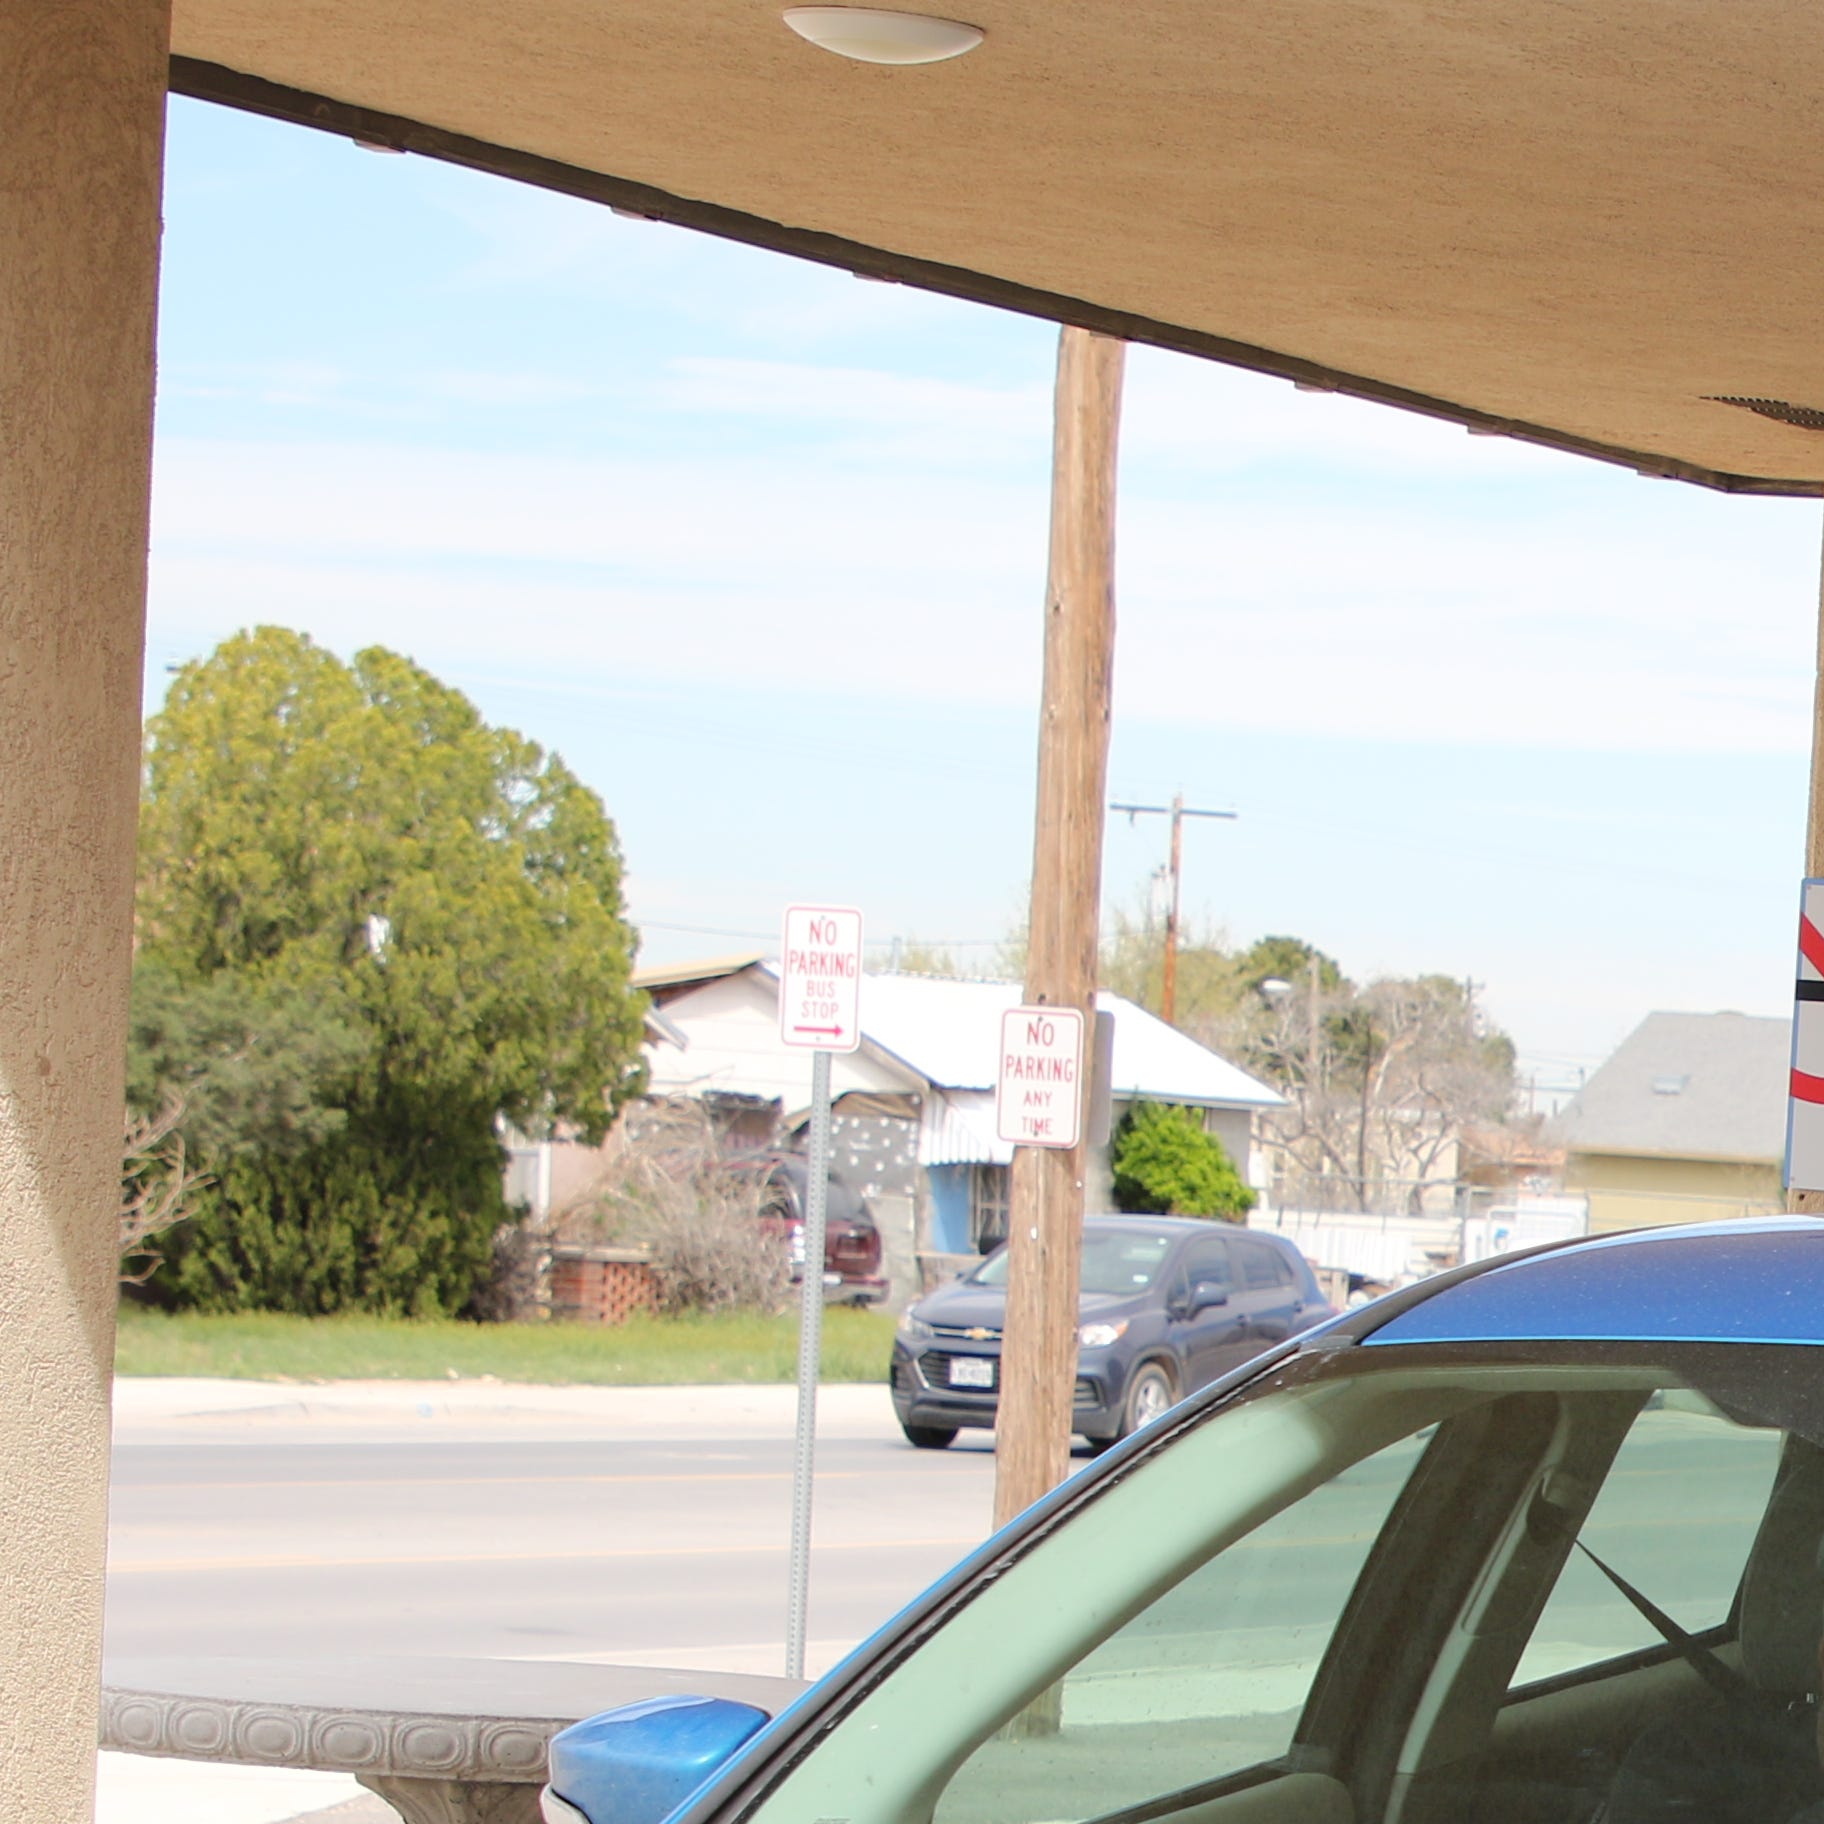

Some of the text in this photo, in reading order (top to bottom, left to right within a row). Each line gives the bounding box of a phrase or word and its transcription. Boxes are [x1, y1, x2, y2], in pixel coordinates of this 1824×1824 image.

[809, 920, 837, 945] NO
[788, 950, 855, 978] PARKING
[806, 980, 836, 998] BUS
[801, 1000, 839, 1019] STOP
[1026, 1021, 1055, 1047] NO
[1005, 1054, 1073, 1083] PARKING
[1023, 1090, 1053, 1107] ANY
[1021, 1116, 1054, 1135] TIME
